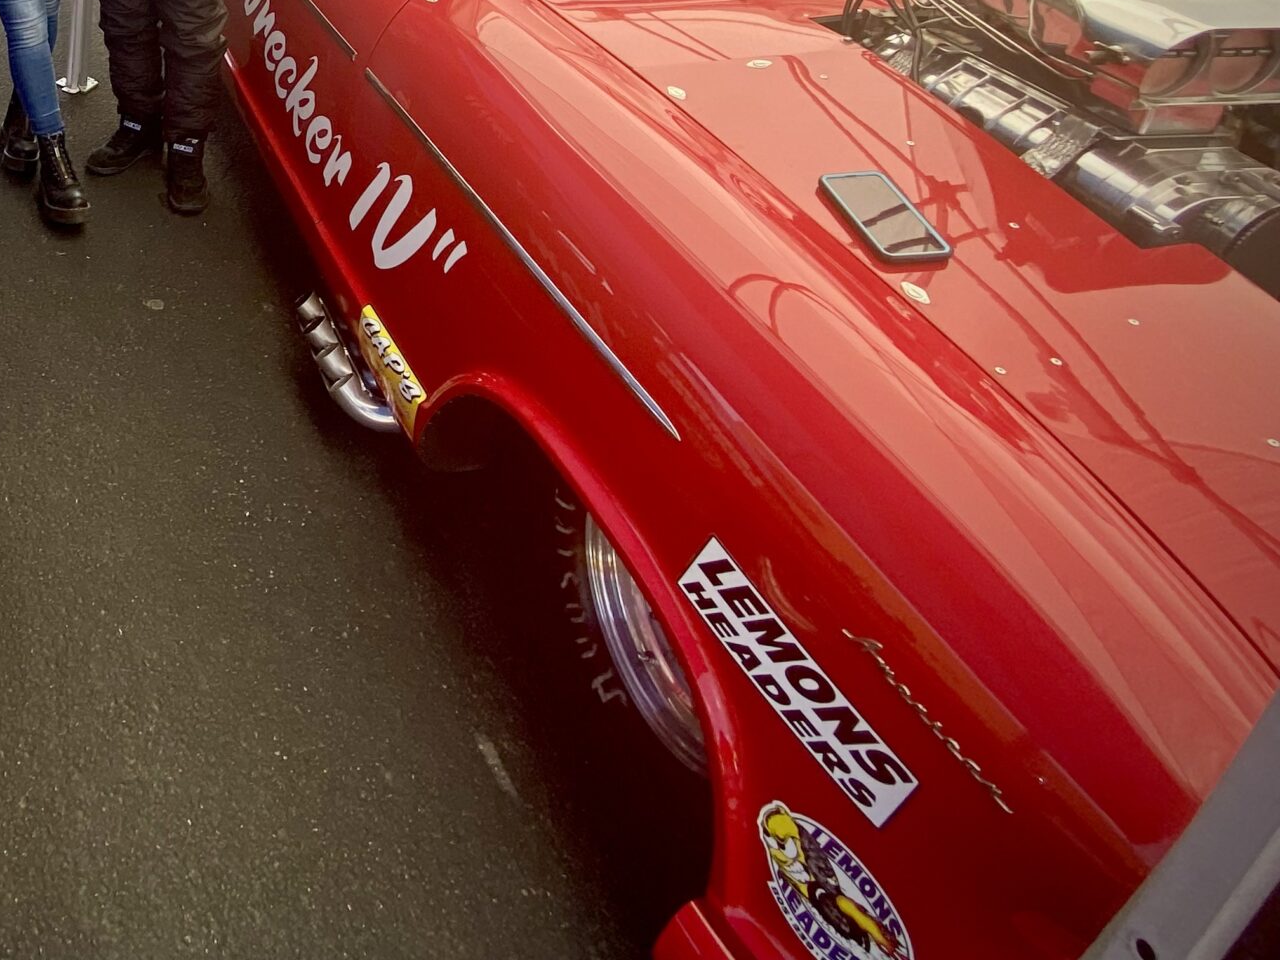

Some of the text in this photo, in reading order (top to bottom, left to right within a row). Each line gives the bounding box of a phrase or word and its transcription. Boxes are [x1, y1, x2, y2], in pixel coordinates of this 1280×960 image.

[682, 581, 877, 808] HEADERS
[698, 558, 914, 786] LEMONS
[811, 827, 903, 937] LEMONS
